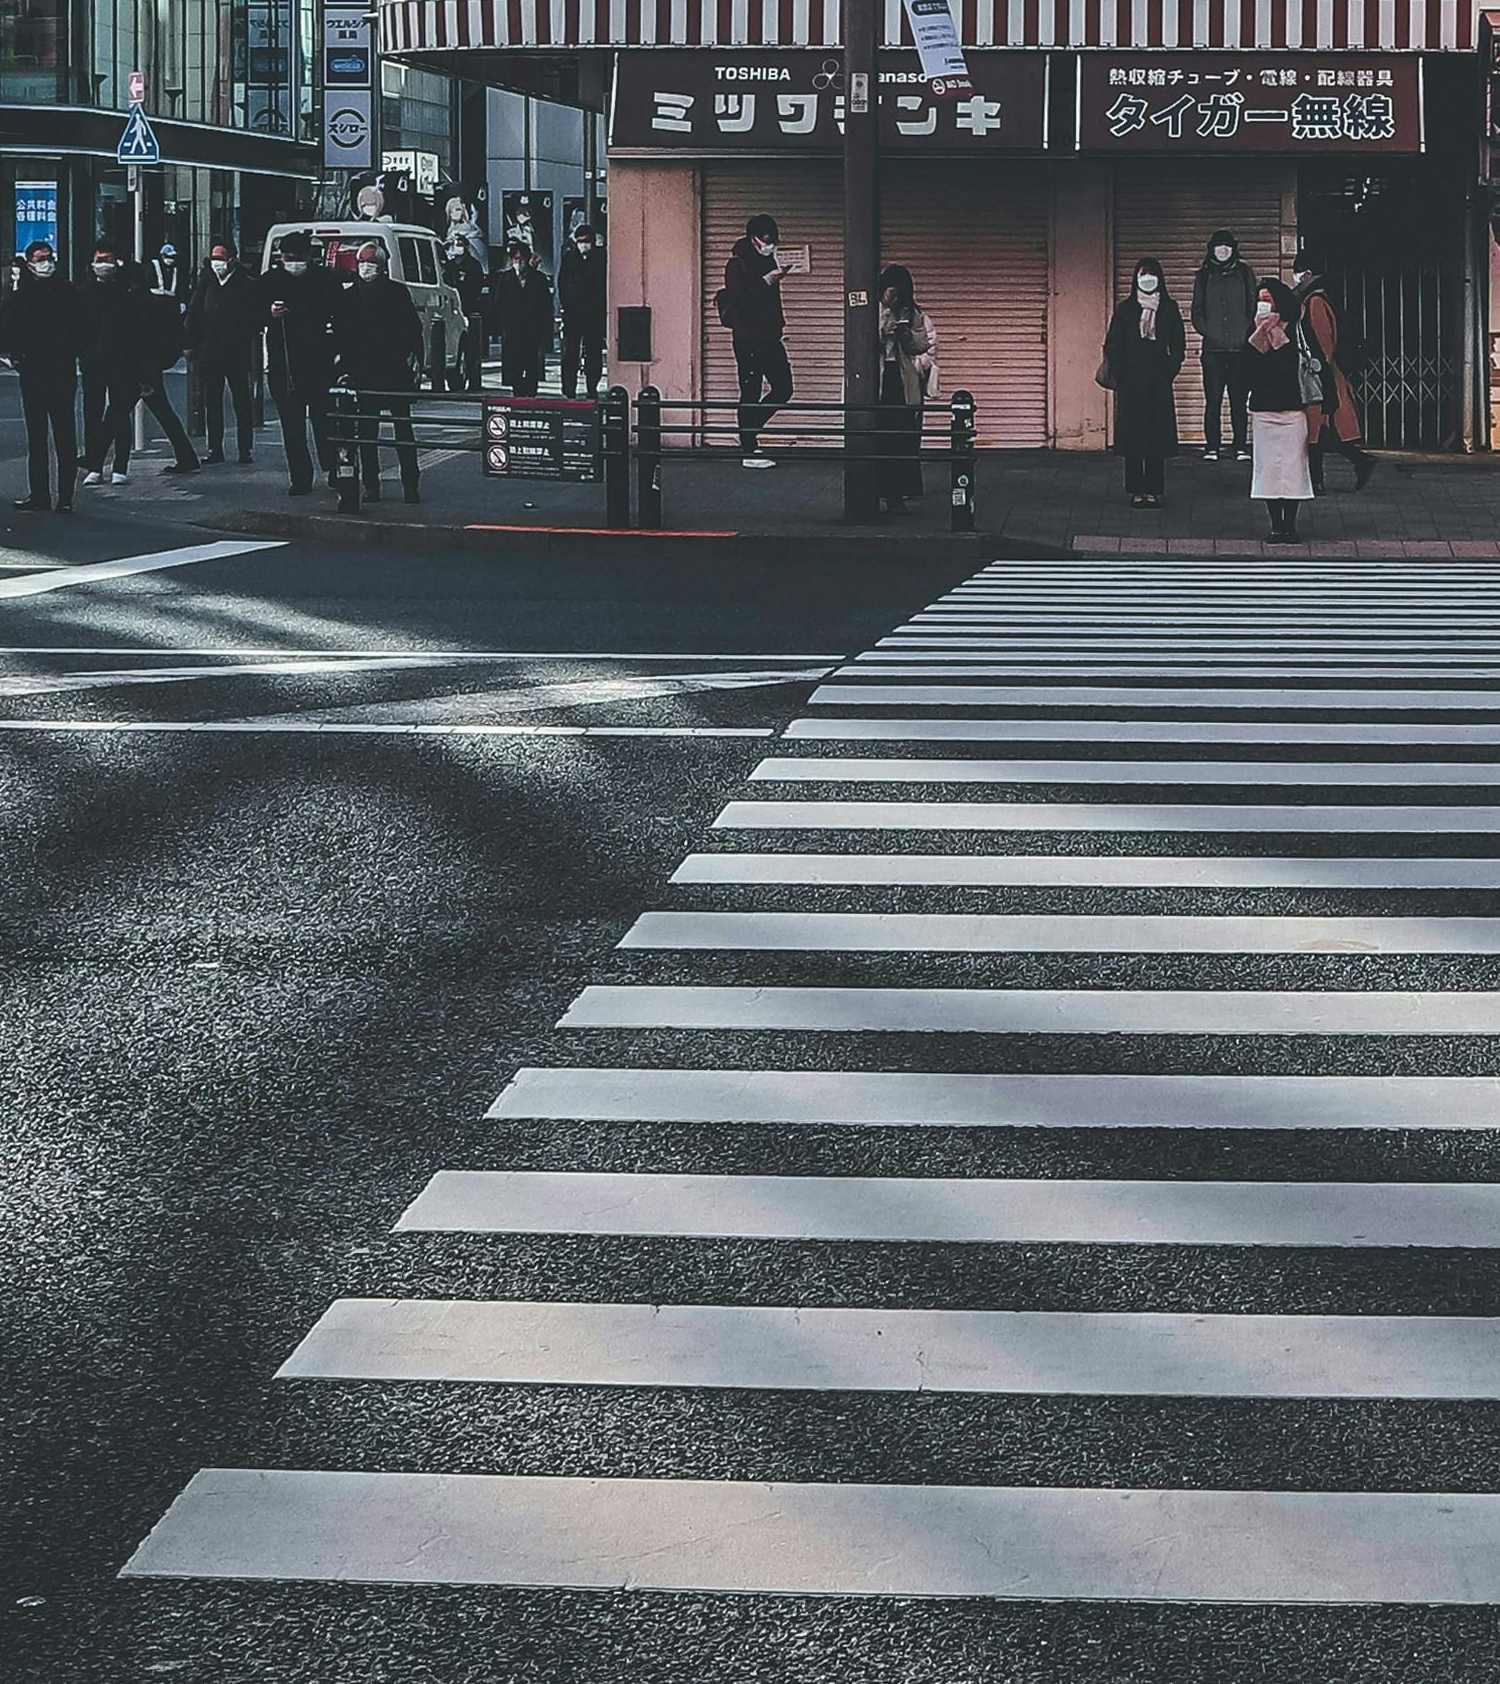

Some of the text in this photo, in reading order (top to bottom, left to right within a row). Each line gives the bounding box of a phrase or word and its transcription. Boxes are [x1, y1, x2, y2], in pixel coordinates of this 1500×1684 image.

[715, 66, 792, 82] TOSHIBA
[878, 70, 929, 84] anaso
[1105, 92, 1398, 141] タイガー無線
[327, 122, 369, 133] スシロー
